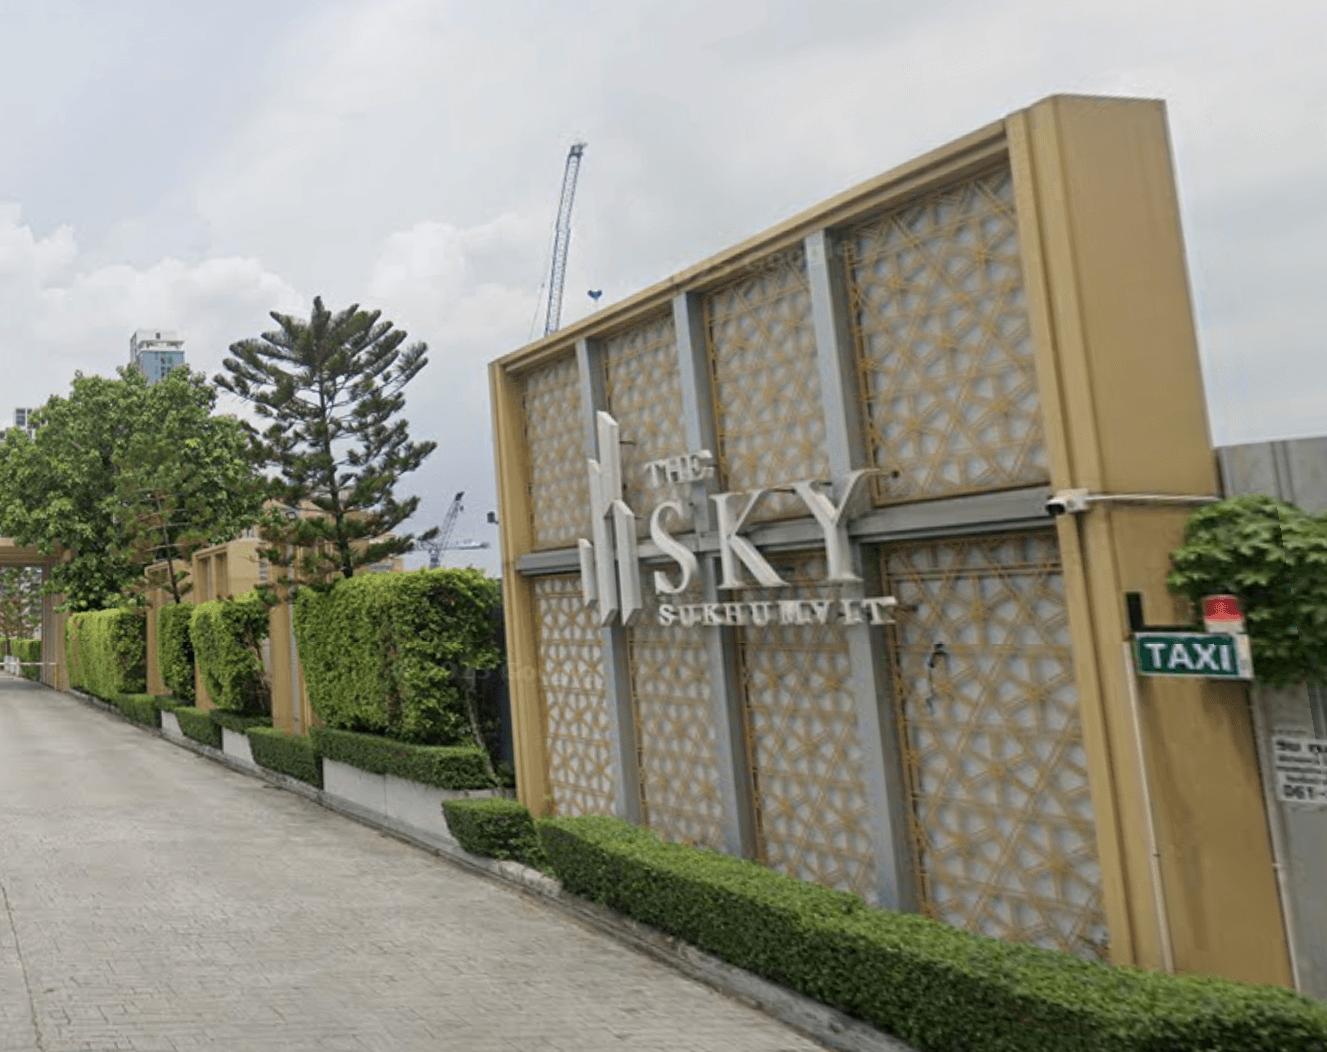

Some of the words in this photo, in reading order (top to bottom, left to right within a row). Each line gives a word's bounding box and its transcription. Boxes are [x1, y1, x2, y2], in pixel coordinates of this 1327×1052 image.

[645, 450, 714, 487] THE
[651, 468, 883, 594] SKY
[659, 595, 897, 627] SUKHUMVIT
[1143, 643, 1233, 671] TAXI
